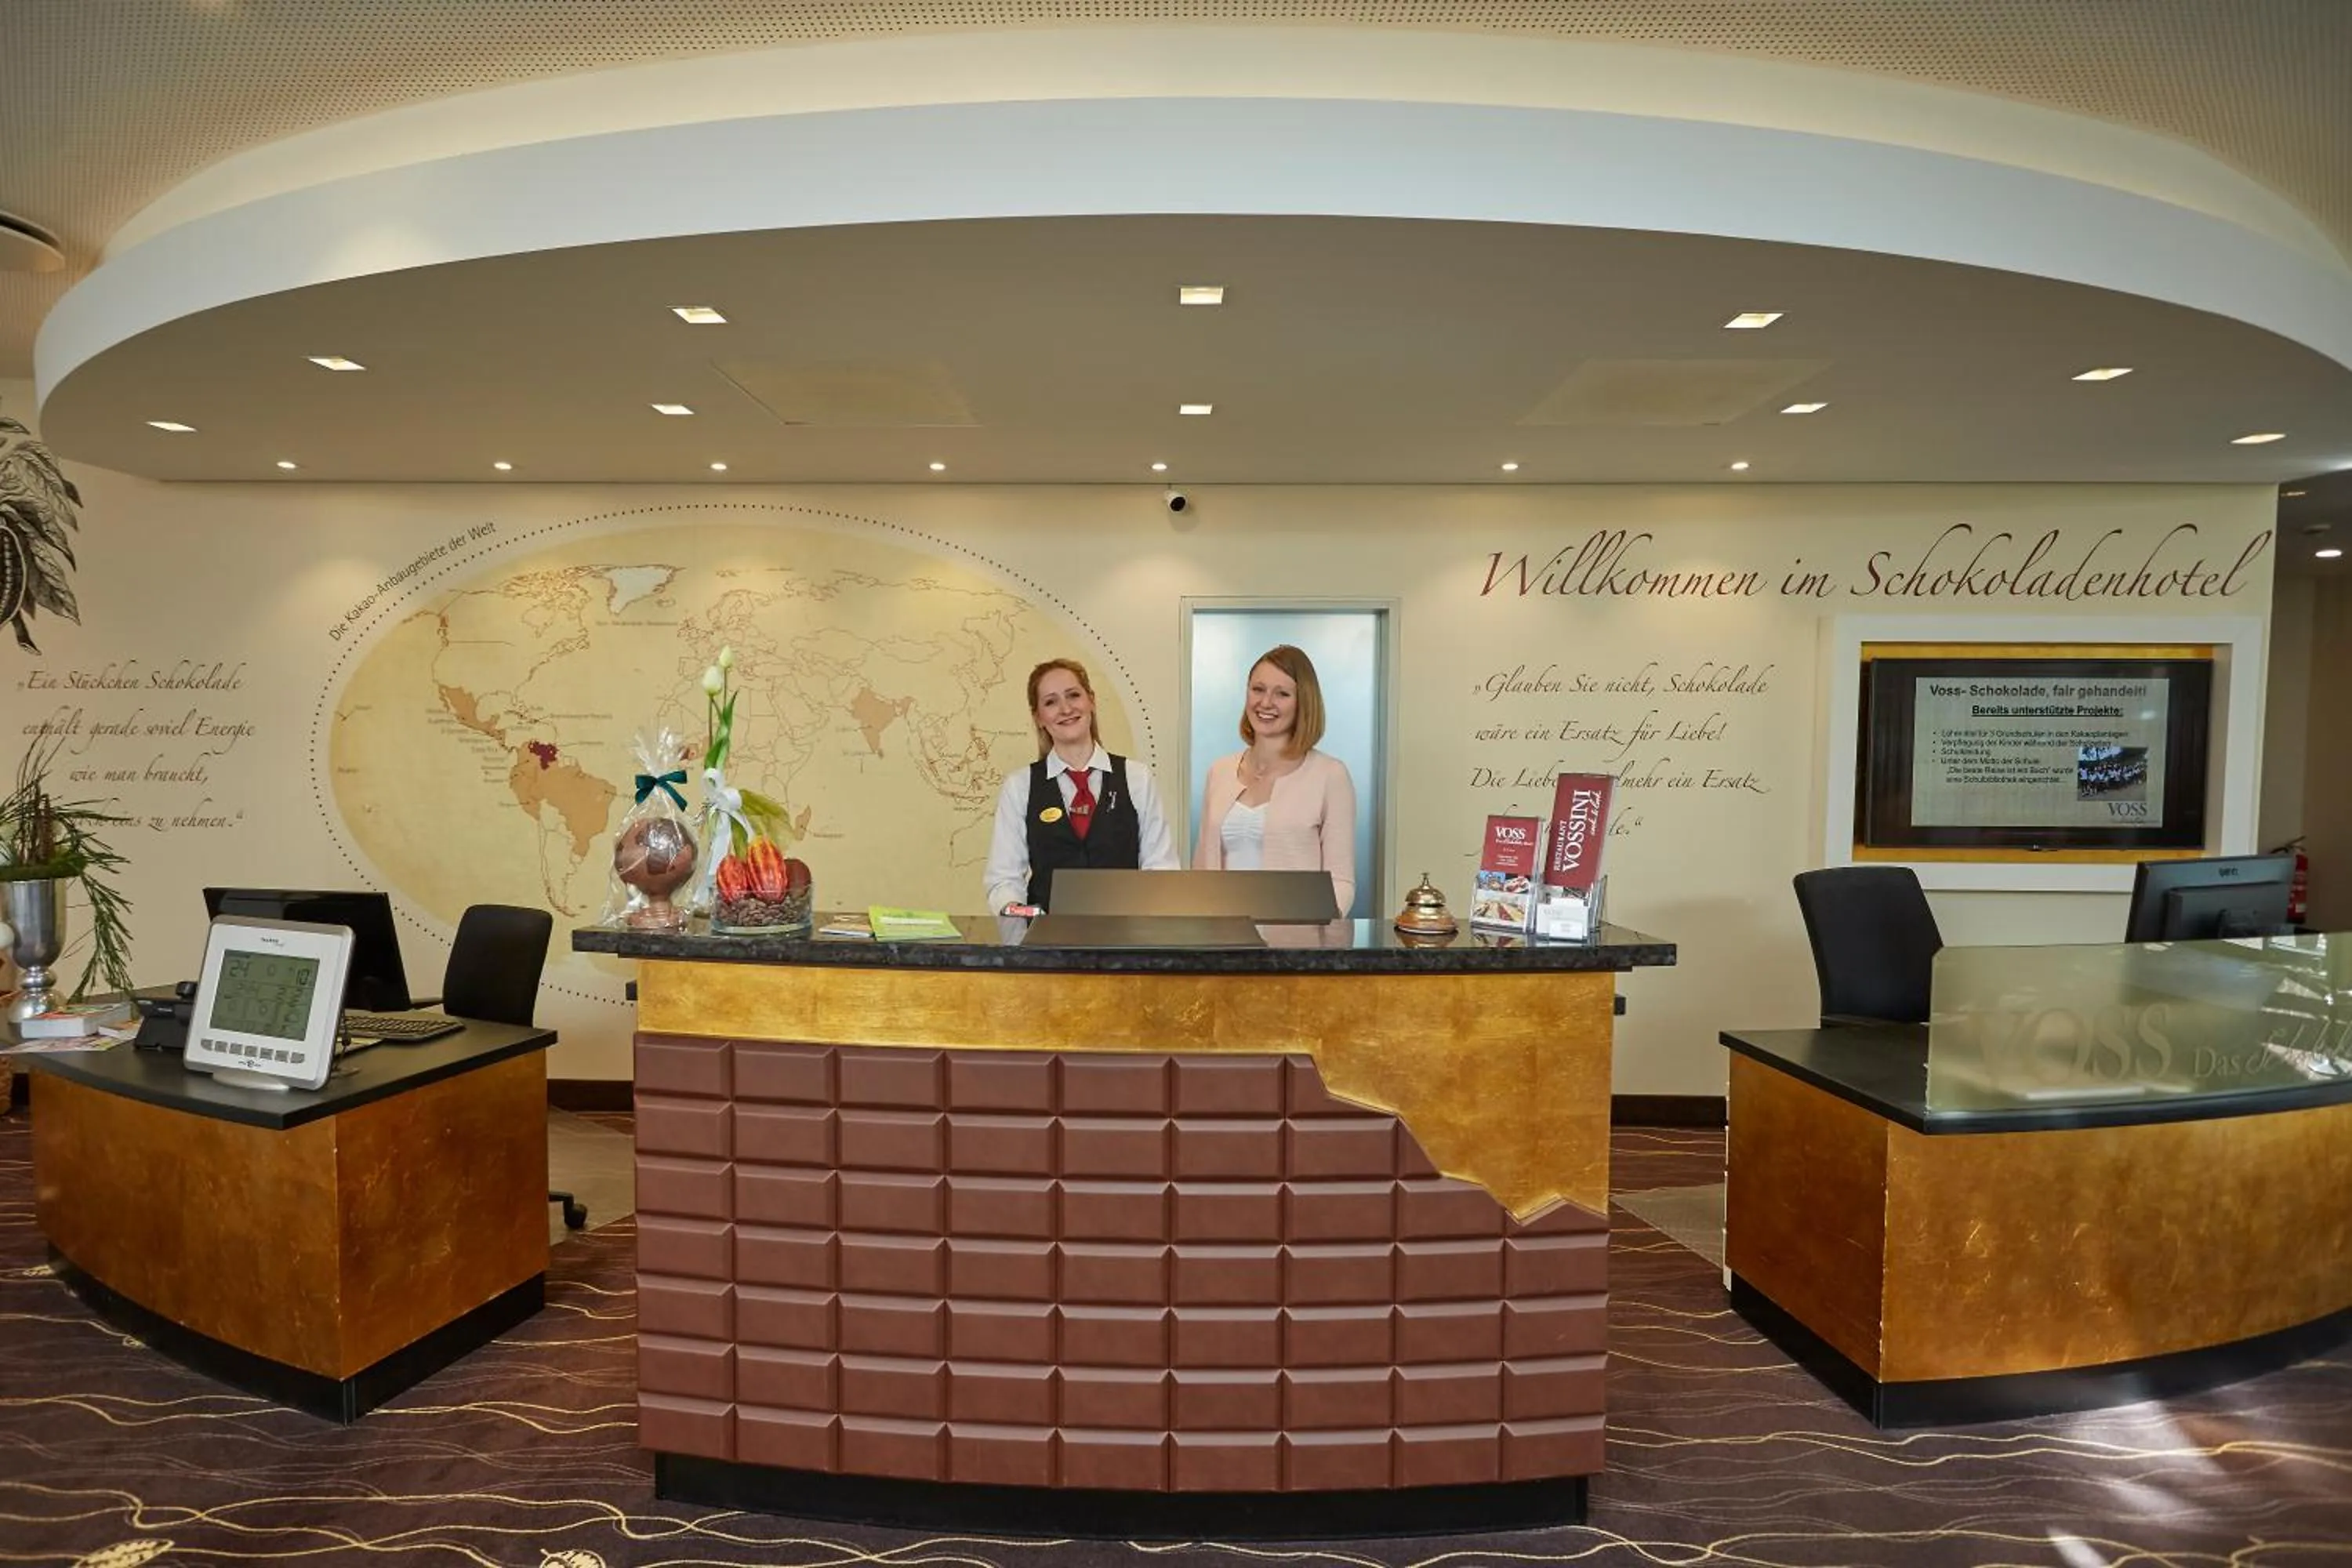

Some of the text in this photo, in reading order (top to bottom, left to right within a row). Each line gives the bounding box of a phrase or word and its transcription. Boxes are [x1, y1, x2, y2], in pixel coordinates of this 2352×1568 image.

[1480, 523, 2272, 601] Willkommen im Schokoladenhotel
[328, 521, 496, 641] Die Kakao-Anbaugebiete der Welt
[64, 659, 139, 689] Stückchen
[145, 659, 247, 691] Schokolade
[1570, 673, 1599, 693] Sie
[1605, 662, 1657, 697] nicht,
[1663, 662, 1775, 694] Schokolade
[1930, 684, 1965, 697] Voss-
[1969, 684, 2049, 699] Schokolade,
[2053, 684, 2074, 697] fair
[1972, 706, 2123, 716] Bereits unterstützte Projekte:
[71, 708, 144, 754] gerade
[147, 708, 197, 736] soviel
[194, 716, 256, 755] Energie
[1475, 710, 1728, 763] wäre ein Ersatz für Liebe!
[70, 752, 212, 784] wie man braucht,
[1470, 768, 1507, 788] Die
[1667, 771, 1695, 788] ein
[1701, 769, 1770, 793] Ersatz
[148, 817, 168, 832] zu
[2107, 802, 2147, 815] VOSS
[1494, 826, 1526, 840] VOSS
[1553, 820, 1567, 872] RESTAURANT
[1563, 789, 1591, 873] VOSSINI
[2193, 1046, 2240, 1078] Das
